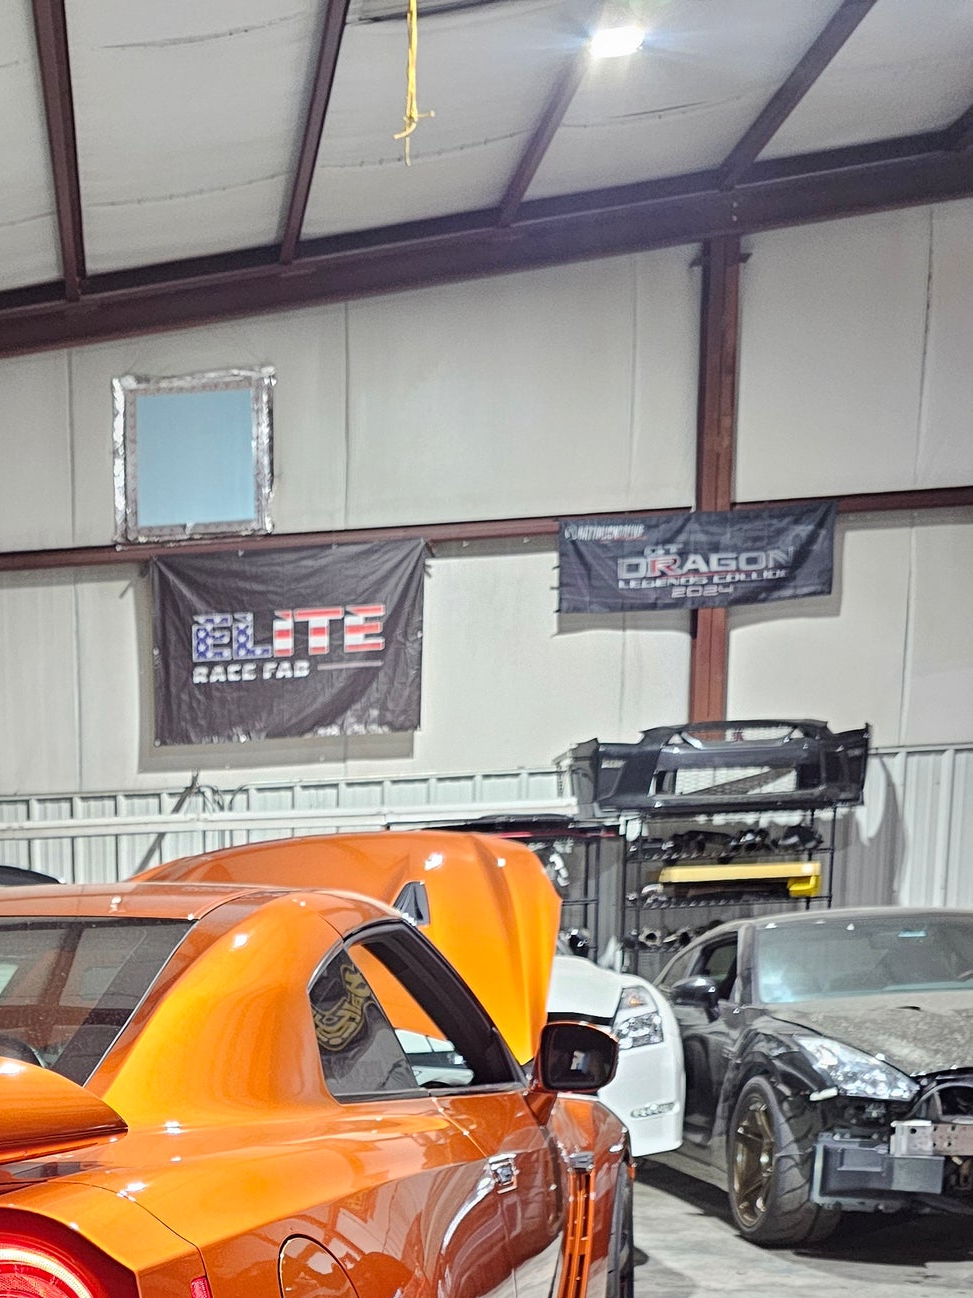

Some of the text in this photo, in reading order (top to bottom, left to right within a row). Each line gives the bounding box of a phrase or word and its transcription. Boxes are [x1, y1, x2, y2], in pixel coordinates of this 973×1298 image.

[617, 547, 795, 579] DRAGON
[618, 576, 709, 590] LEGENDS
[671, 584, 735, 599] 2024
[191, 603, 386, 663] ELITE
[192, 660, 311, 684] RACE FAB
